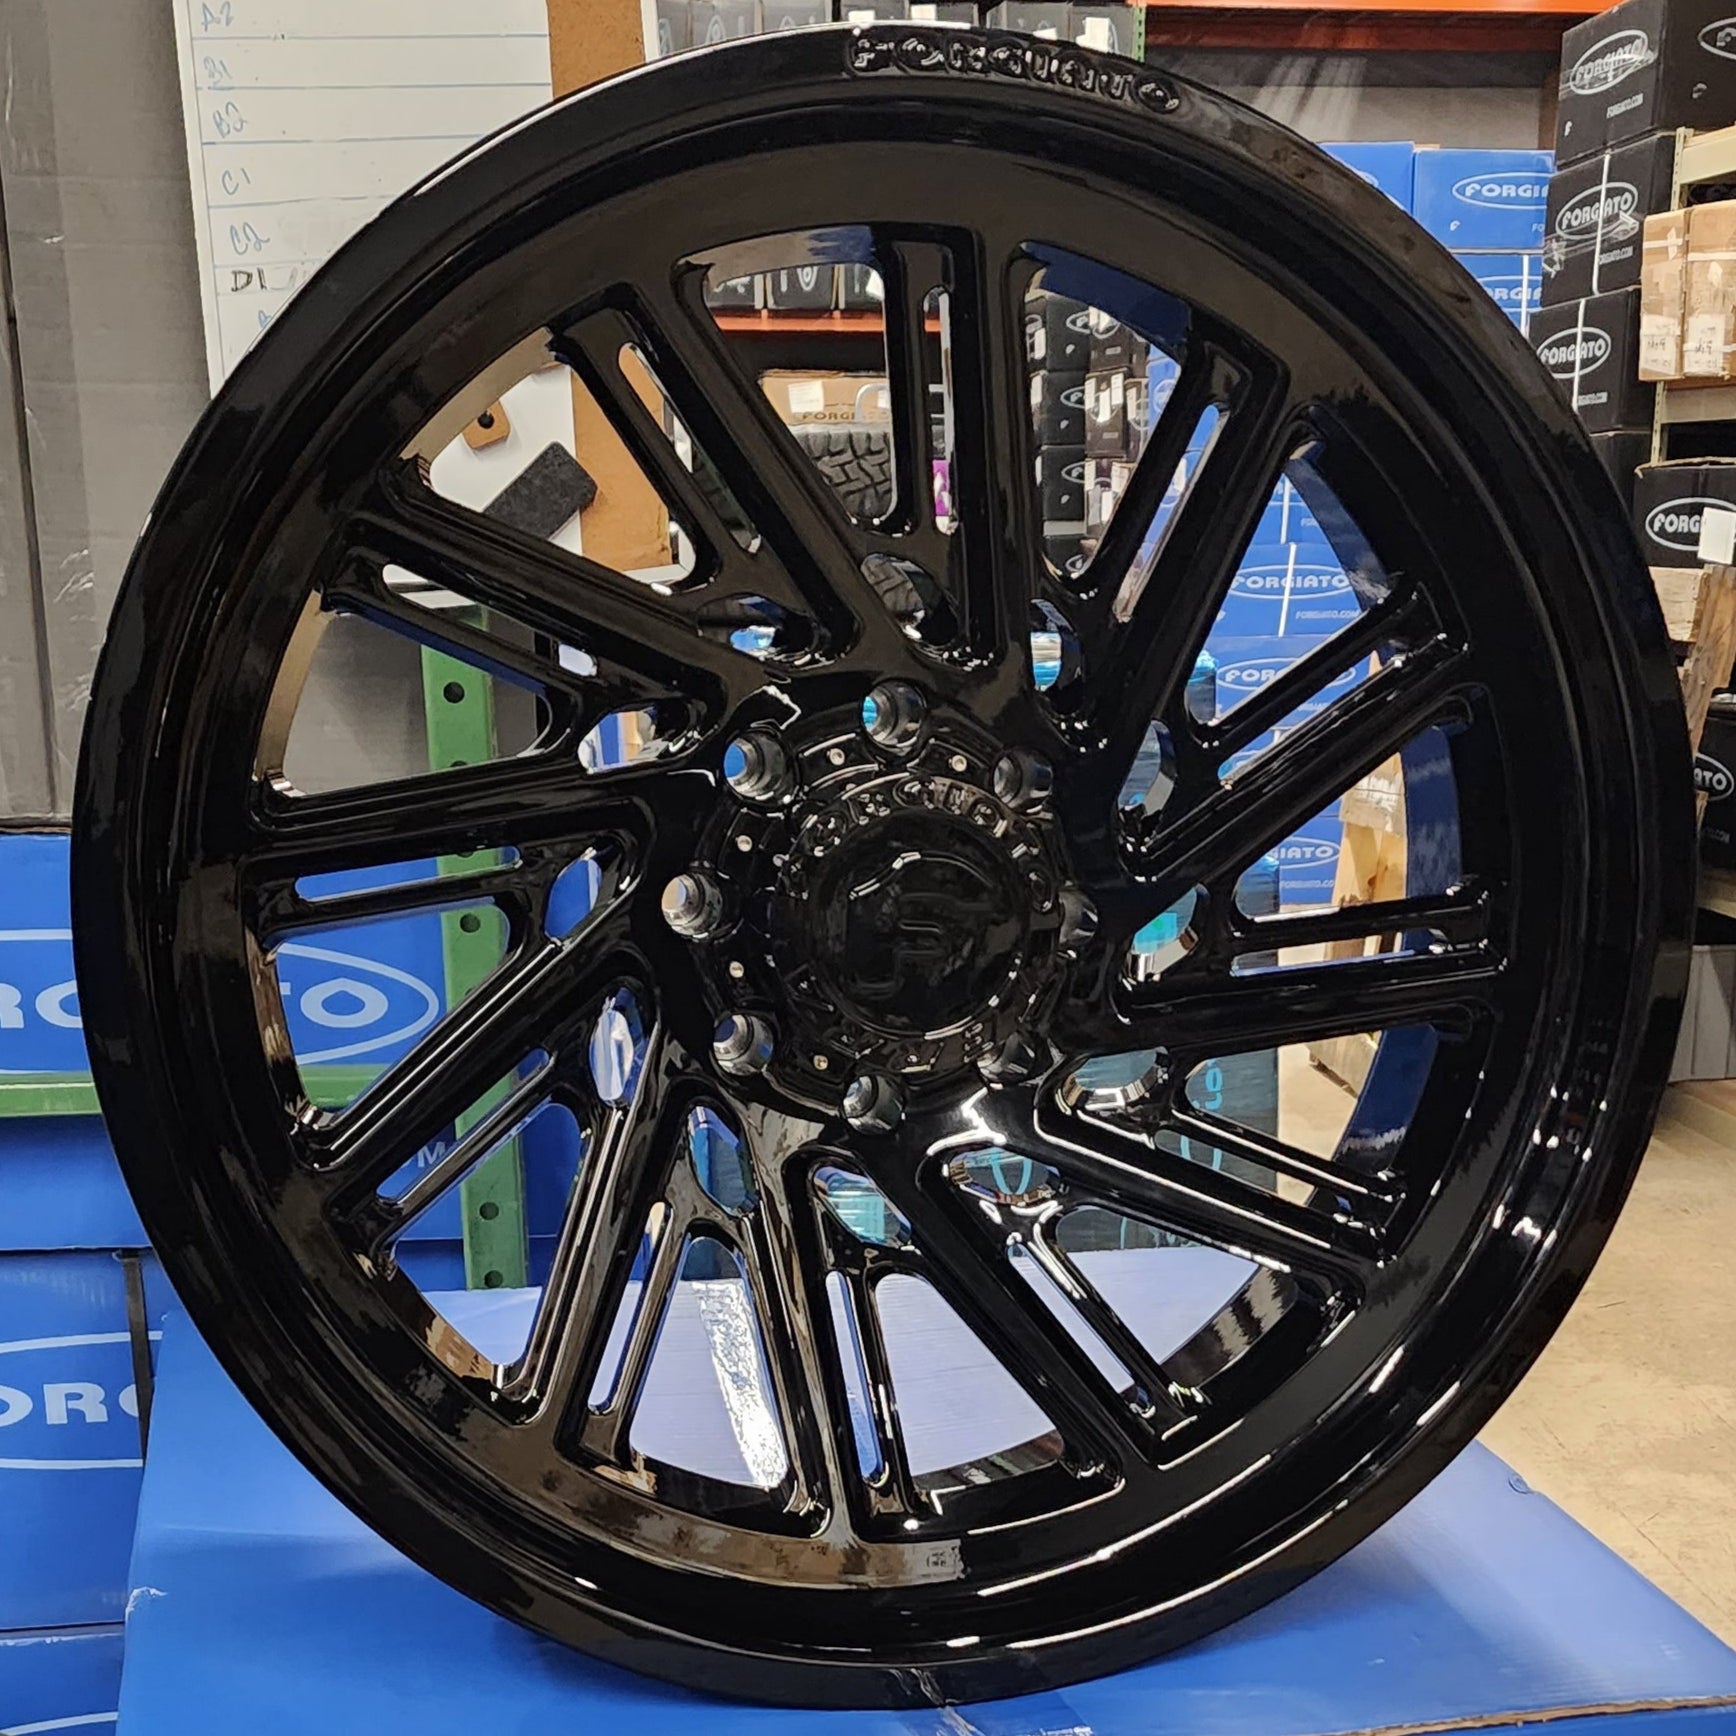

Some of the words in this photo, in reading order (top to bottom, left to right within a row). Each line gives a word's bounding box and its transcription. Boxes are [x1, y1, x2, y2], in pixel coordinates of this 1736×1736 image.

[201, 1, 234, 32] A2
[213, 101, 249, 139] B2
[221, 167, 252, 195] C1
[1561, 191, 1633, 230] FORGATO
[230, 222, 271, 256] C2
[231, 267, 268, 292] D1
[1540, 338, 1607, 365] FORGATO
